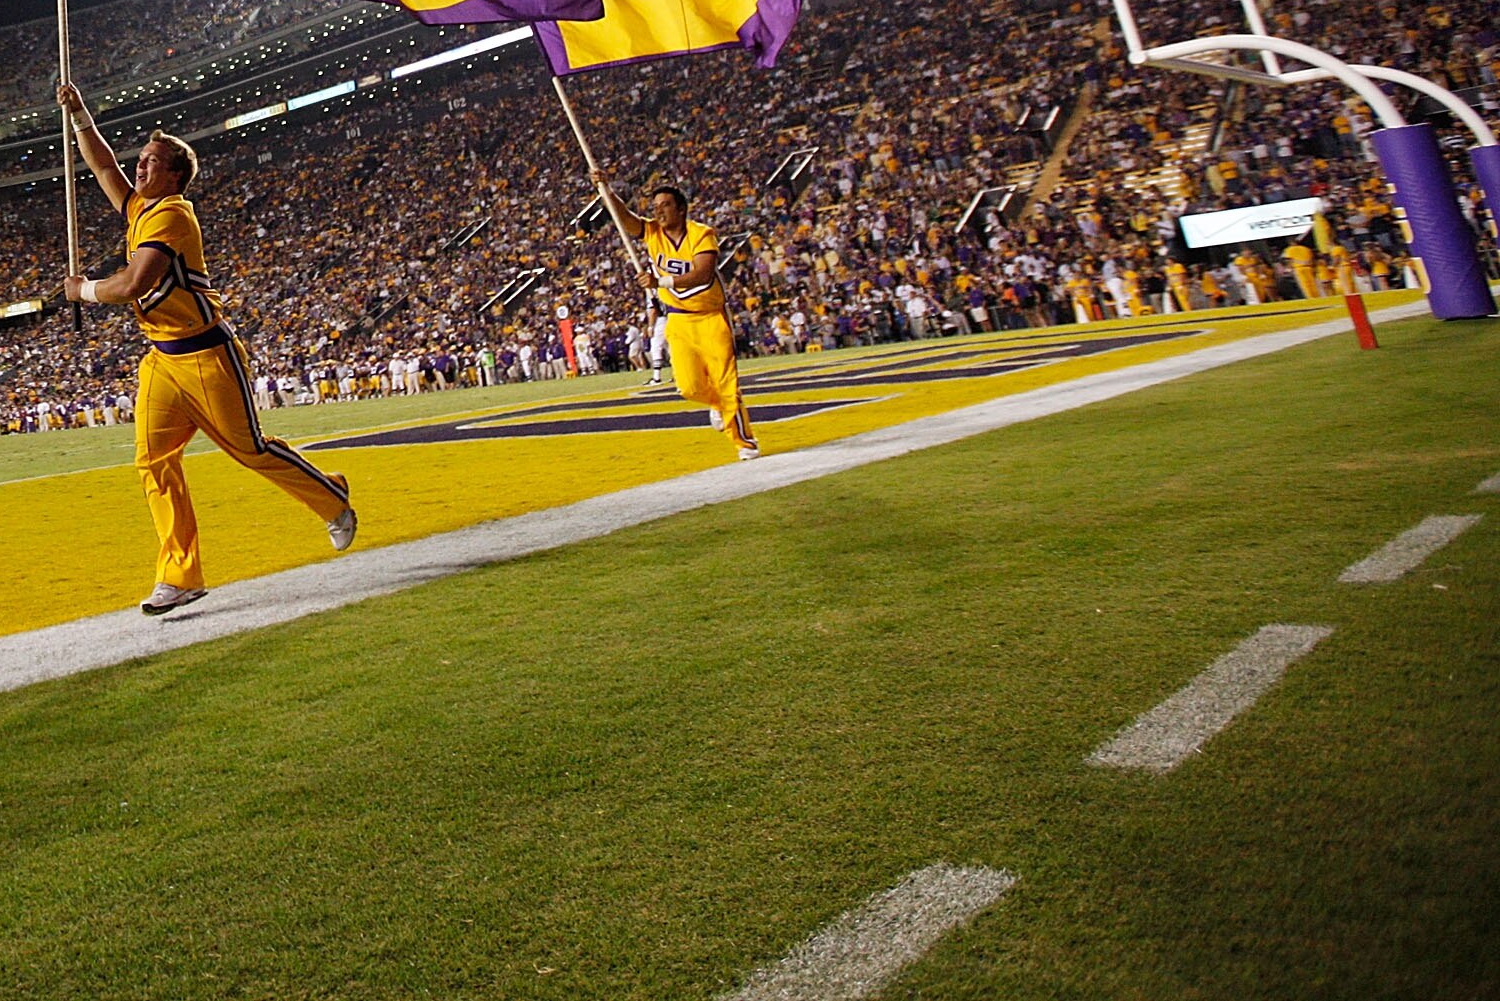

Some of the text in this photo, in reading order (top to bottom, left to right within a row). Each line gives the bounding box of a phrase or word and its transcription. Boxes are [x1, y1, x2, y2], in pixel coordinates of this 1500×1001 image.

[448, 97, 467, 111] 102
[346, 127, 361, 140] 101
[257, 151, 273, 165] 100
